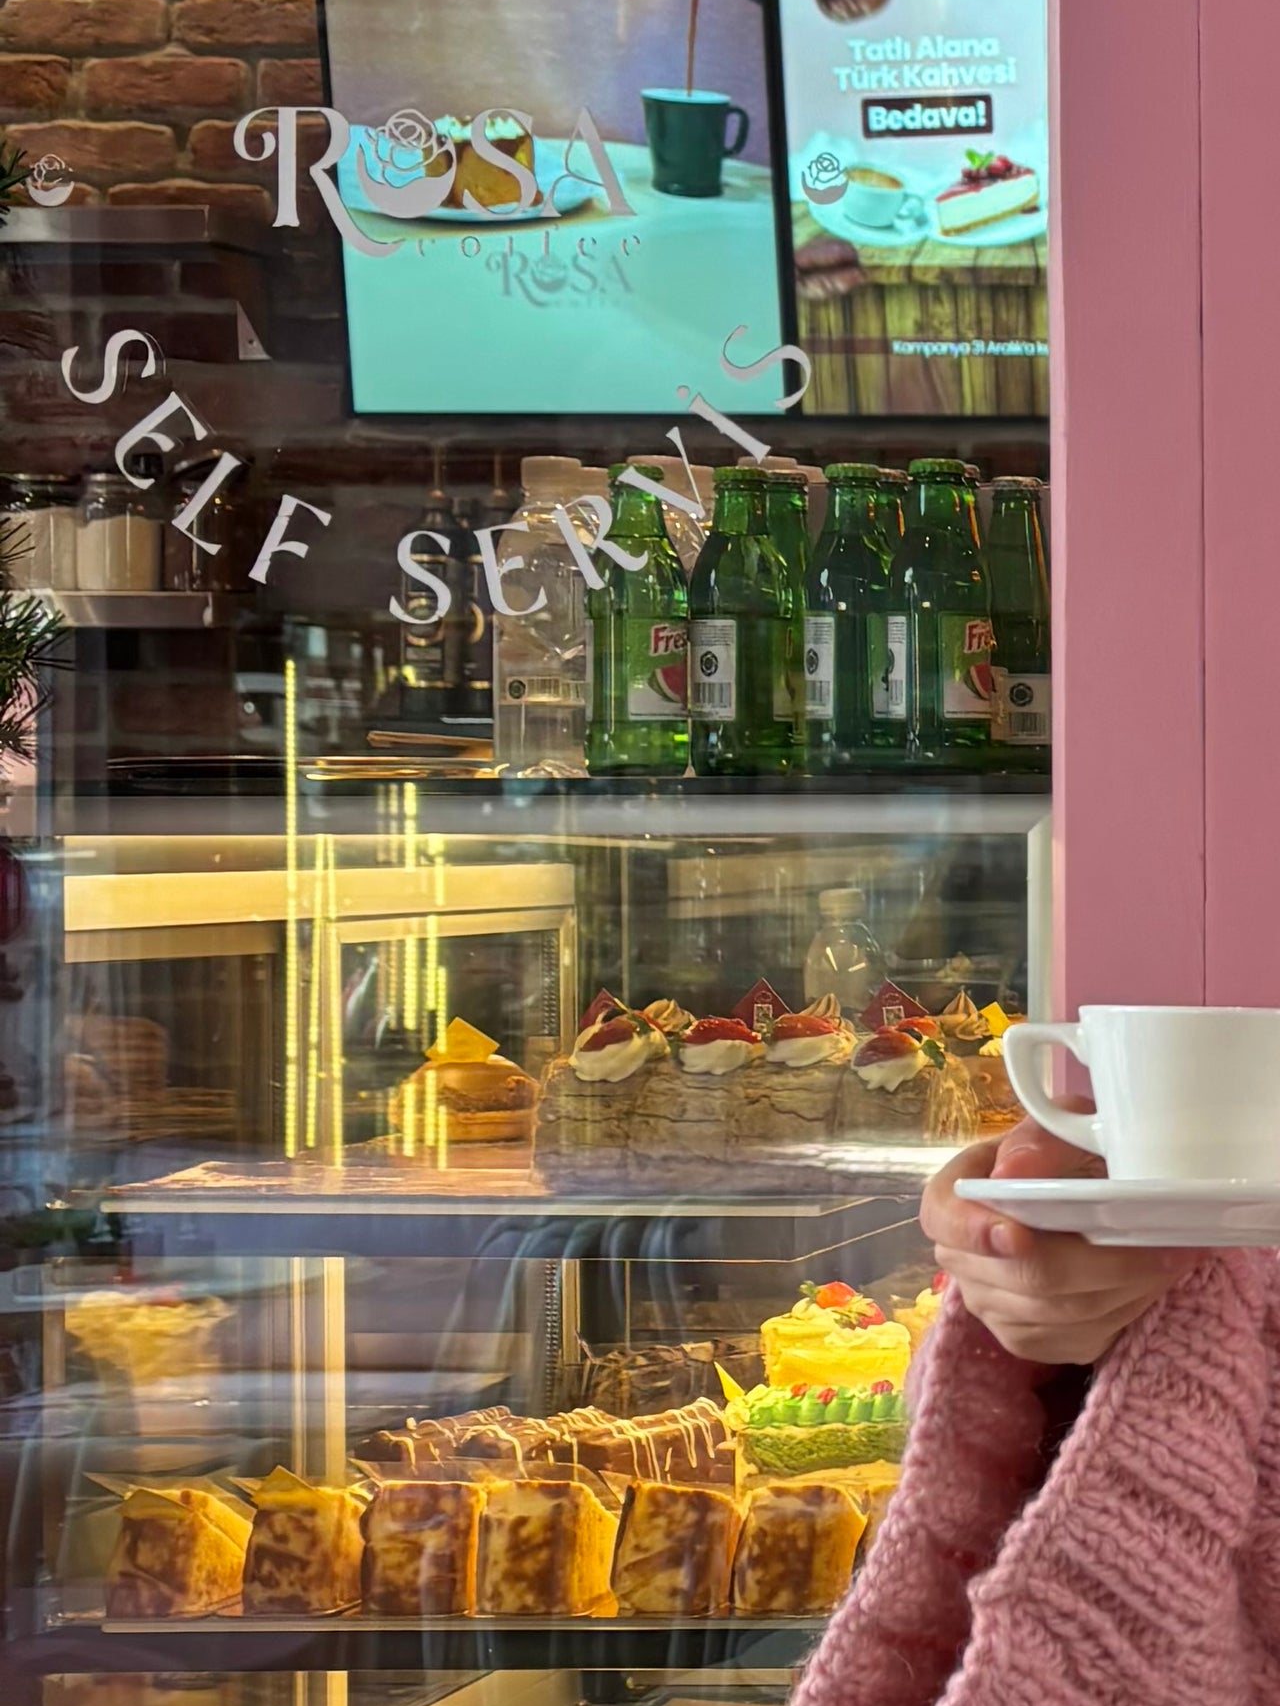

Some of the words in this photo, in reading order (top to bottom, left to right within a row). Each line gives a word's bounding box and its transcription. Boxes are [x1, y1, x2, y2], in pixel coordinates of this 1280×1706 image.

[915, 35, 1001, 60] Alana
[833, 65, 899, 92] Türk
[902, 57, 1017, 88] Kahvesi
[867, 100, 987, 133] Bedava!
[61, 328, 332, 587] SELF
